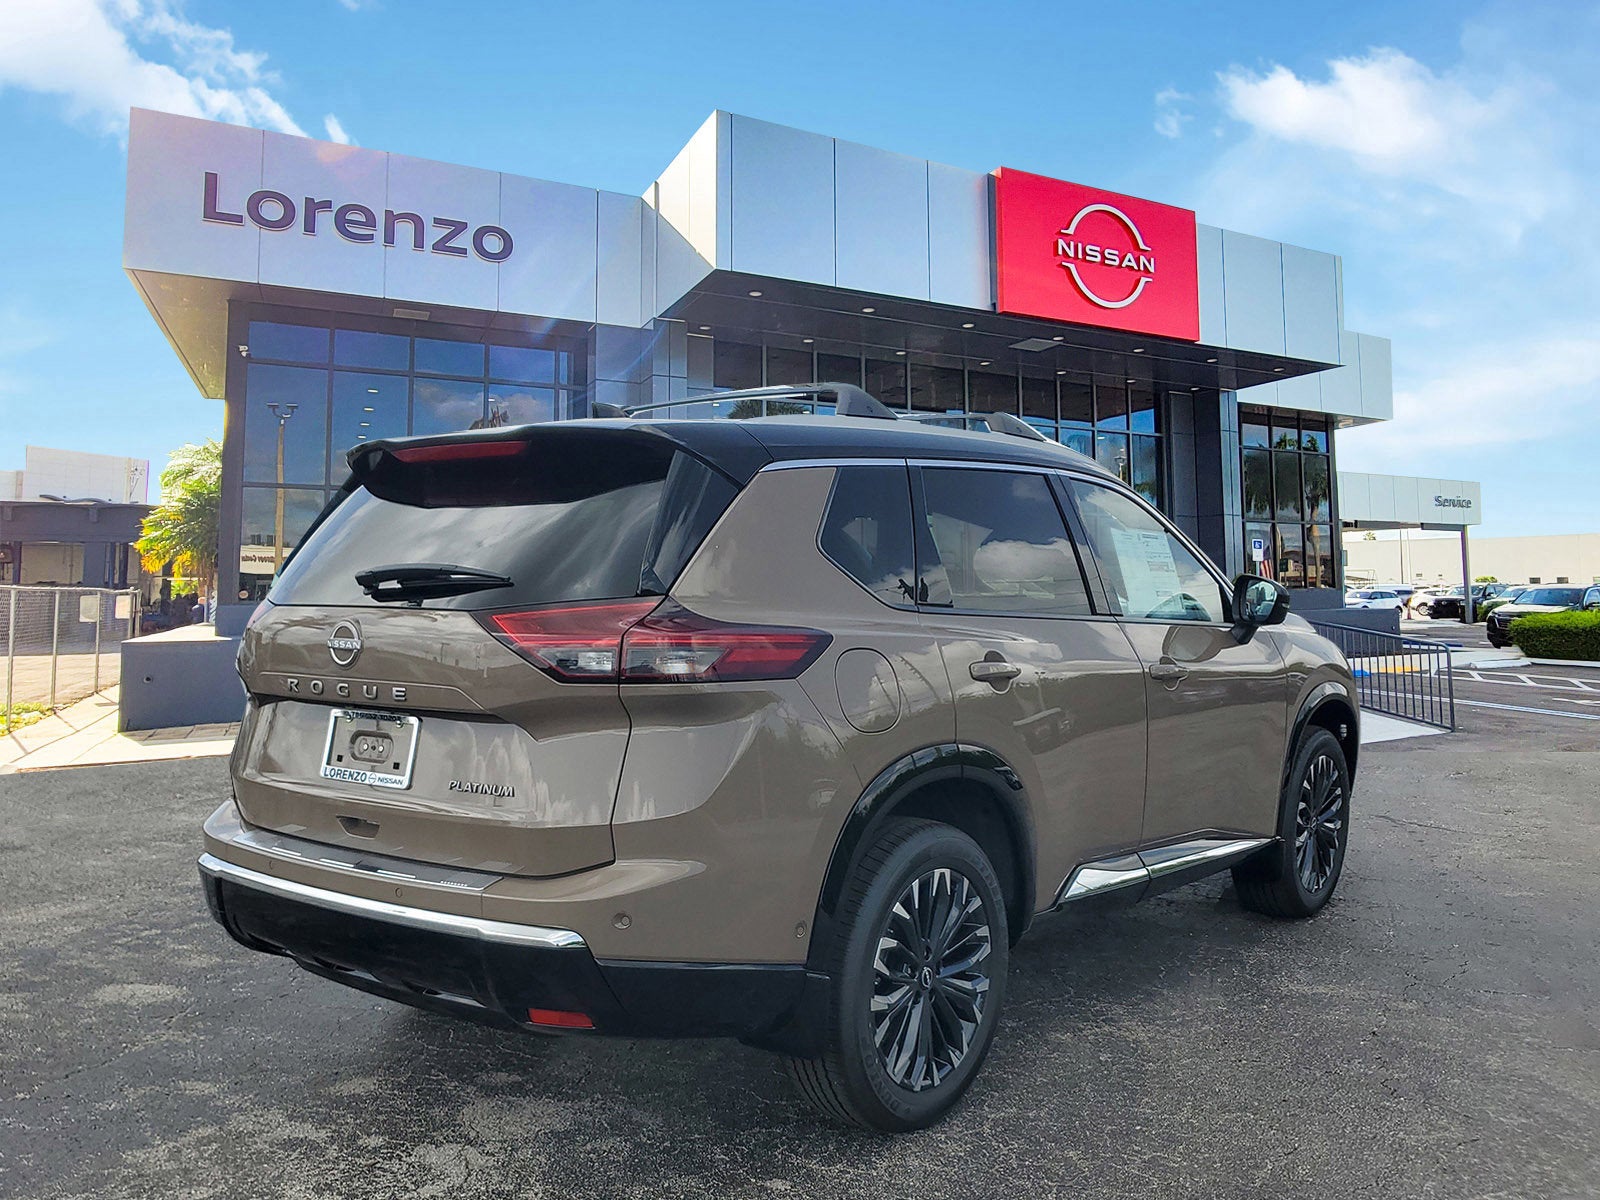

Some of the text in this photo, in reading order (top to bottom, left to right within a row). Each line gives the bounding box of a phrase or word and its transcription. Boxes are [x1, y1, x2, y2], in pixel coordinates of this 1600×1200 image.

[203, 171, 514, 262] Lorenzo
[1057, 238, 1155, 273] NISSAN
[1434, 495, 1472, 508] Service
[327, 639, 361, 650] NISSAN
[287, 678, 408, 701] ROGUE
[323, 766, 404, 786] LORENZO NISSAN
[448, 780, 515, 798] PLATINUM
